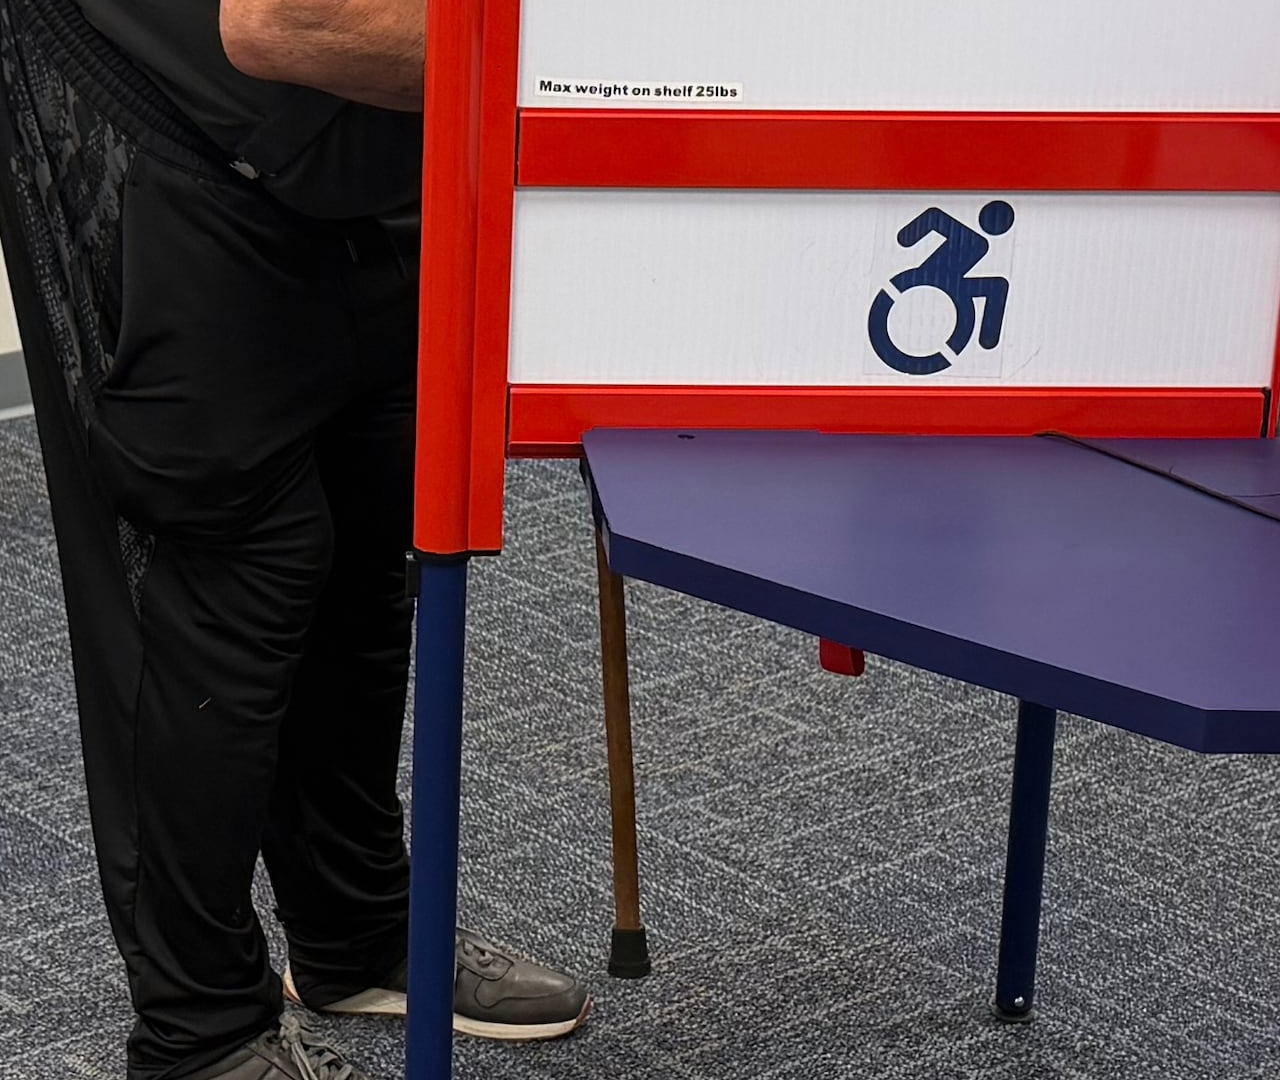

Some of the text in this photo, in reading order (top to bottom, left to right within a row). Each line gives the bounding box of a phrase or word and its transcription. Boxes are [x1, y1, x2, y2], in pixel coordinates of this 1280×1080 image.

[540, 80, 737, 97] Max weight on shelf 25lbs
